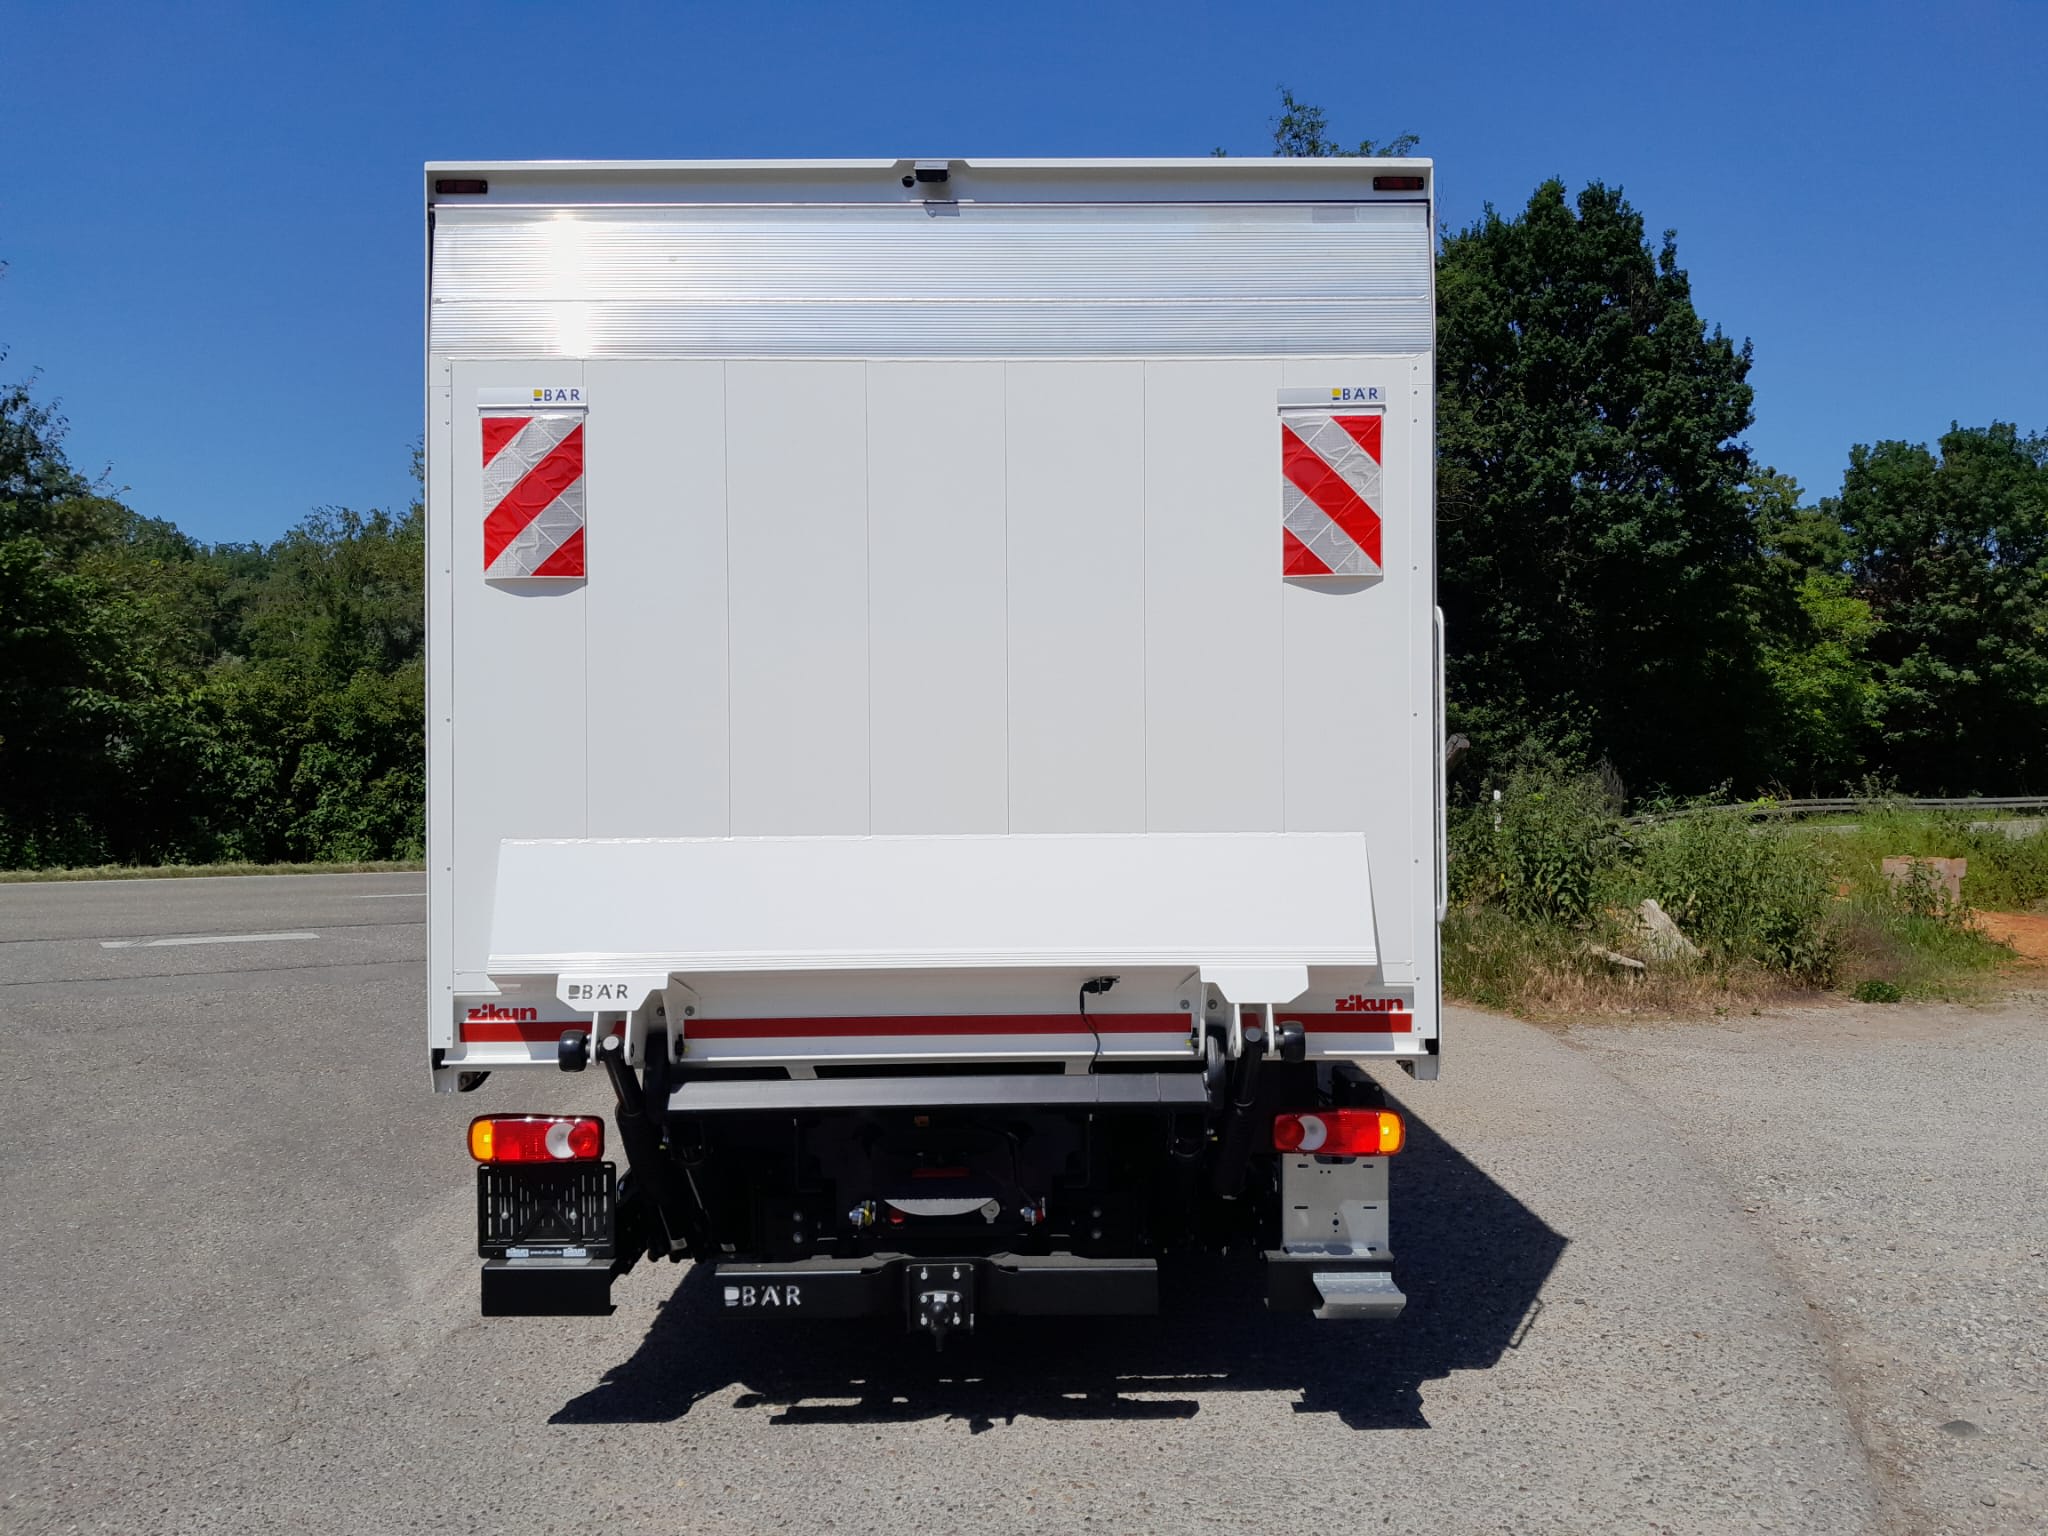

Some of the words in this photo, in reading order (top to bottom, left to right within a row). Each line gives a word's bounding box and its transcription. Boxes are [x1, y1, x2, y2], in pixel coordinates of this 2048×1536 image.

[543, 389, 580, 401] BÄR
[1342, 387, 1378, 400] BÄR
[582, 984, 628, 999] BÄR
[1335, 995, 1404, 1012] zikun
[468, 1003, 537, 1021] zikun
[742, 1285, 801, 1306] BÄR
